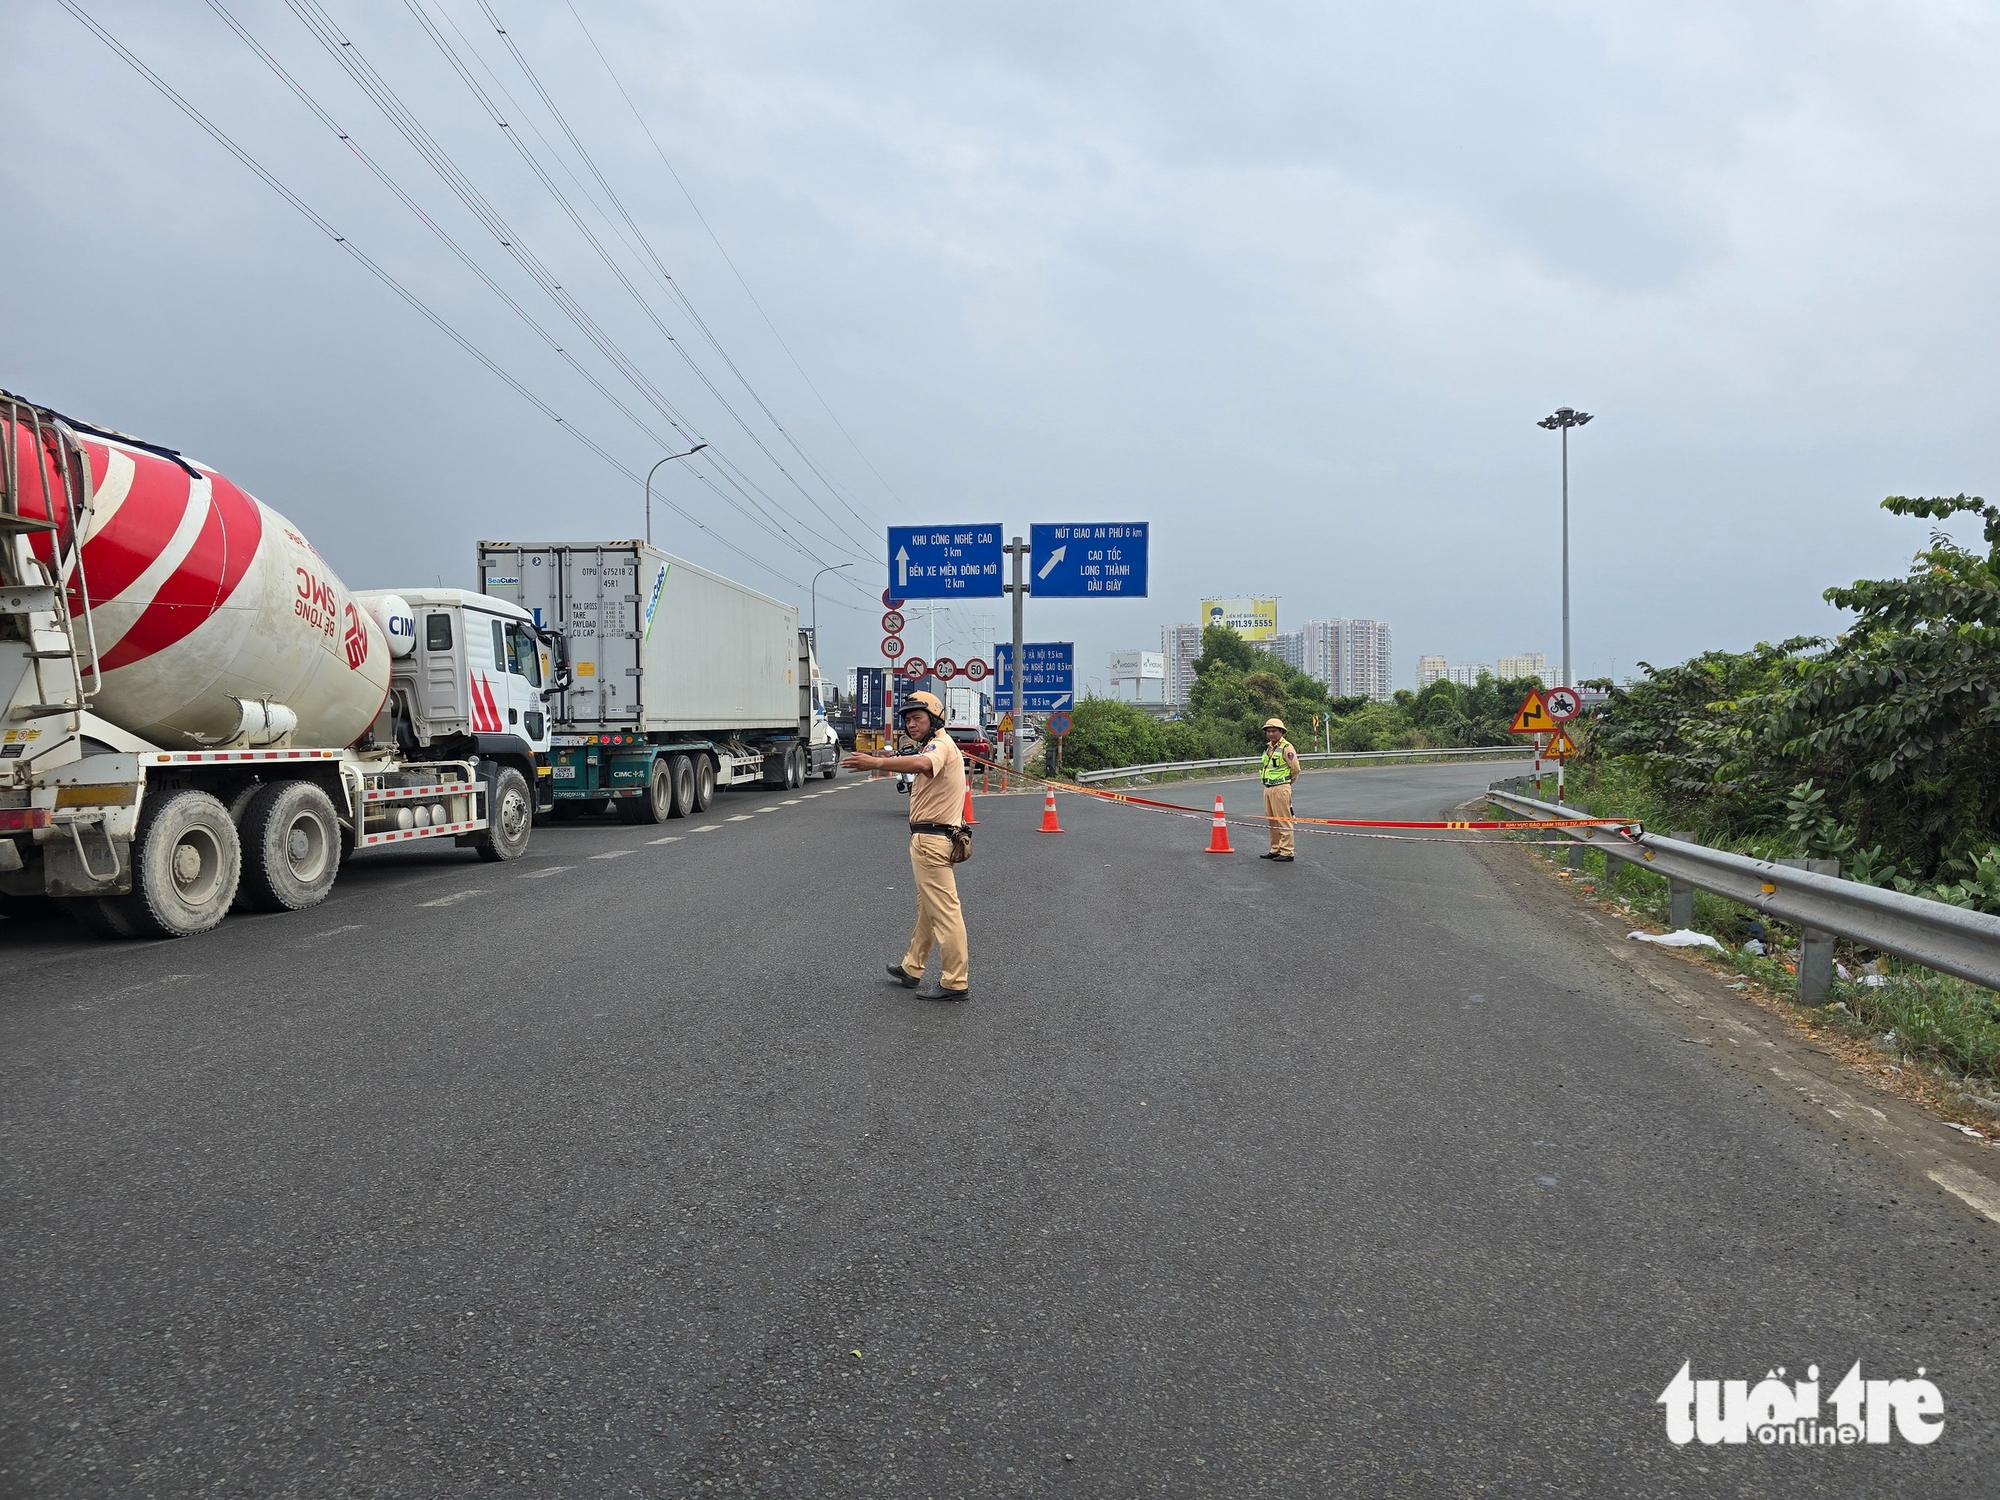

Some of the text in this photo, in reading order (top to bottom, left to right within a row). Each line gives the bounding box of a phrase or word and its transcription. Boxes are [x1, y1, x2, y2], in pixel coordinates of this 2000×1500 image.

[1055, 525, 1142, 539] NÚT GIAO AN PHÚ 6 km
[912, 532, 992, 546] KHU CÔNG NGHỆ CAO
[944, 547, 961, 557] 3 km
[1088, 546, 1122, 560] CAO TỐC
[909, 562, 997, 576] BẾN XE MIỀN ĐÔNG MỚI
[1080, 563, 1130, 576] LONG THÀNH
[945, 578, 964, 588] 12 km
[1088, 577, 1122, 591] DẦU GIÂY
[296, 567, 336, 617] SMC
[1226, 620, 1273, 628] 0911.39.5555
[887, 642, 897, 652] 60
[971, 665, 981, 675] 50
